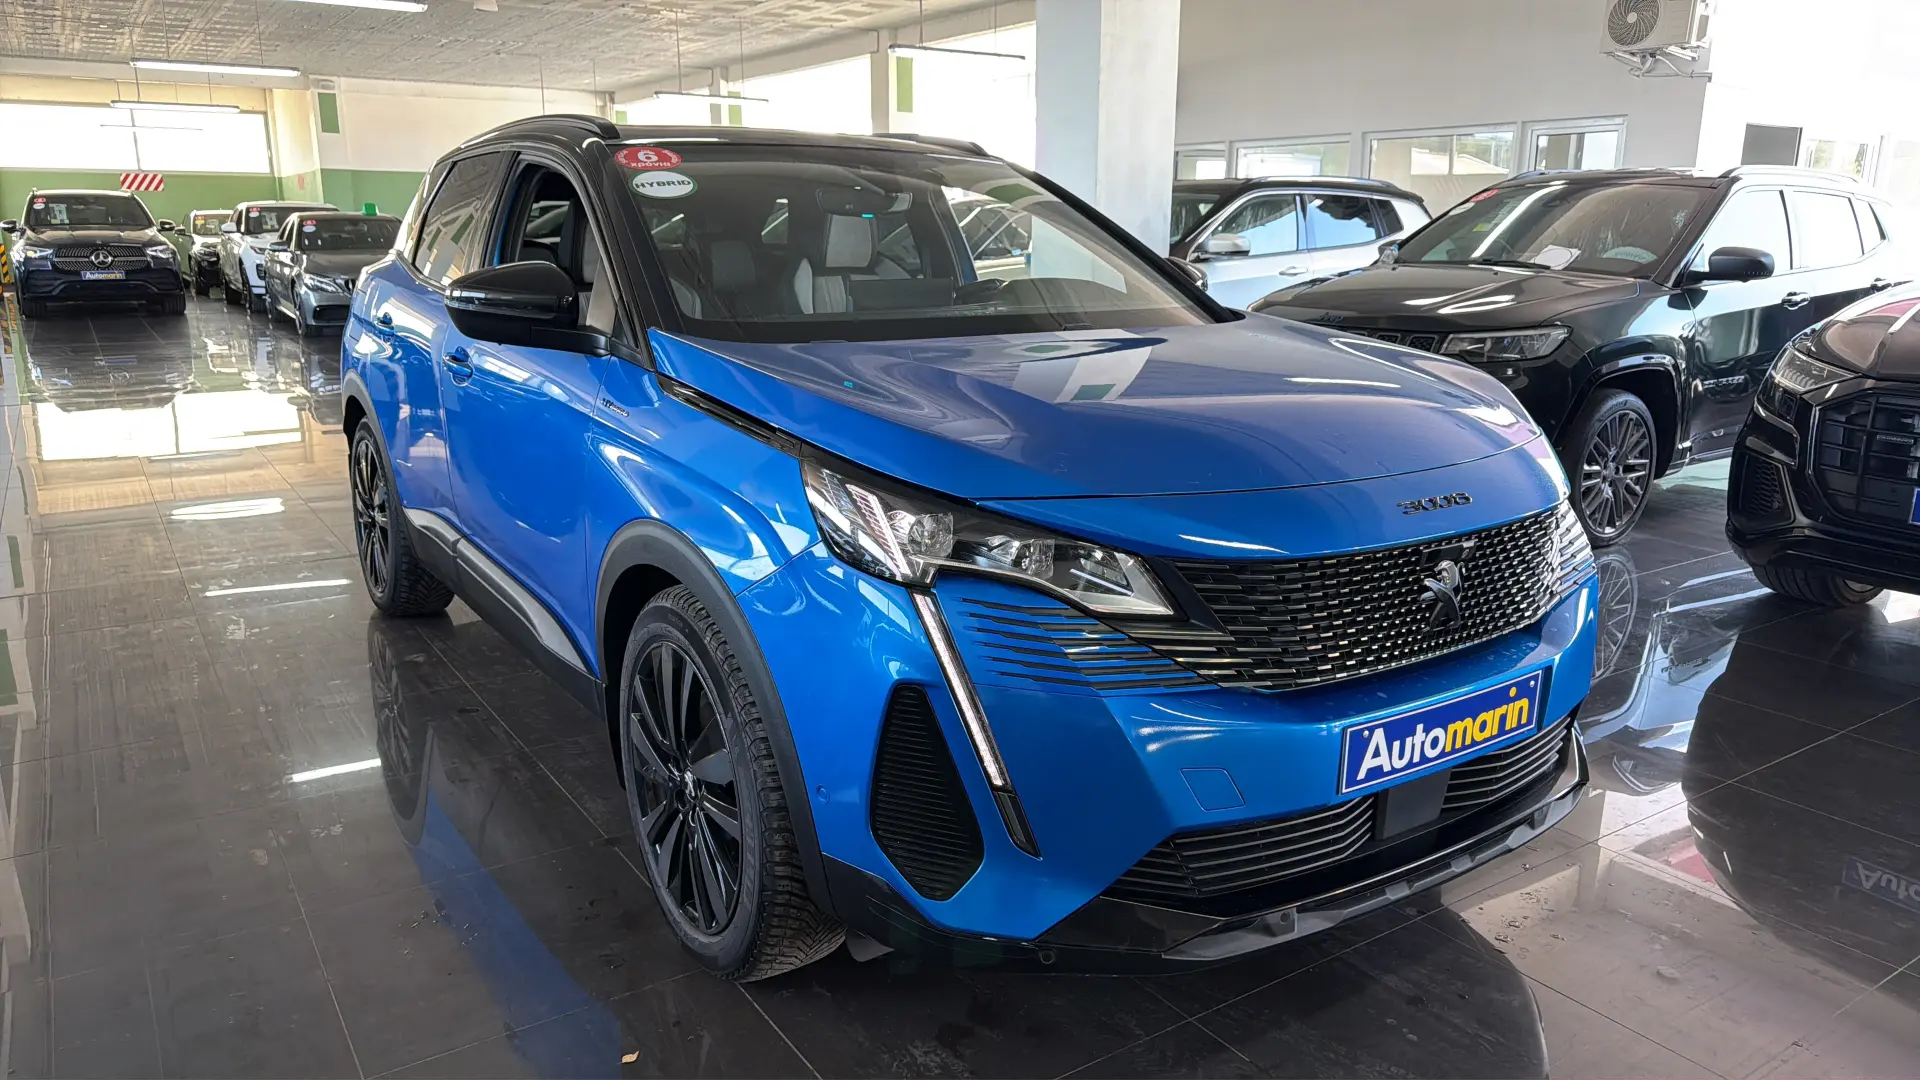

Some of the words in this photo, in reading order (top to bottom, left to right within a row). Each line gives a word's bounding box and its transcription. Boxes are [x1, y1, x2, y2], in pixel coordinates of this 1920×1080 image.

[637, 150, 659, 163] 6
[634, 180, 691, 189] HYBRID
[85, 271, 123, 280] Automarin
[1396, 492, 1473, 515] 3008
[1356, 686, 1530, 781] Automarin
